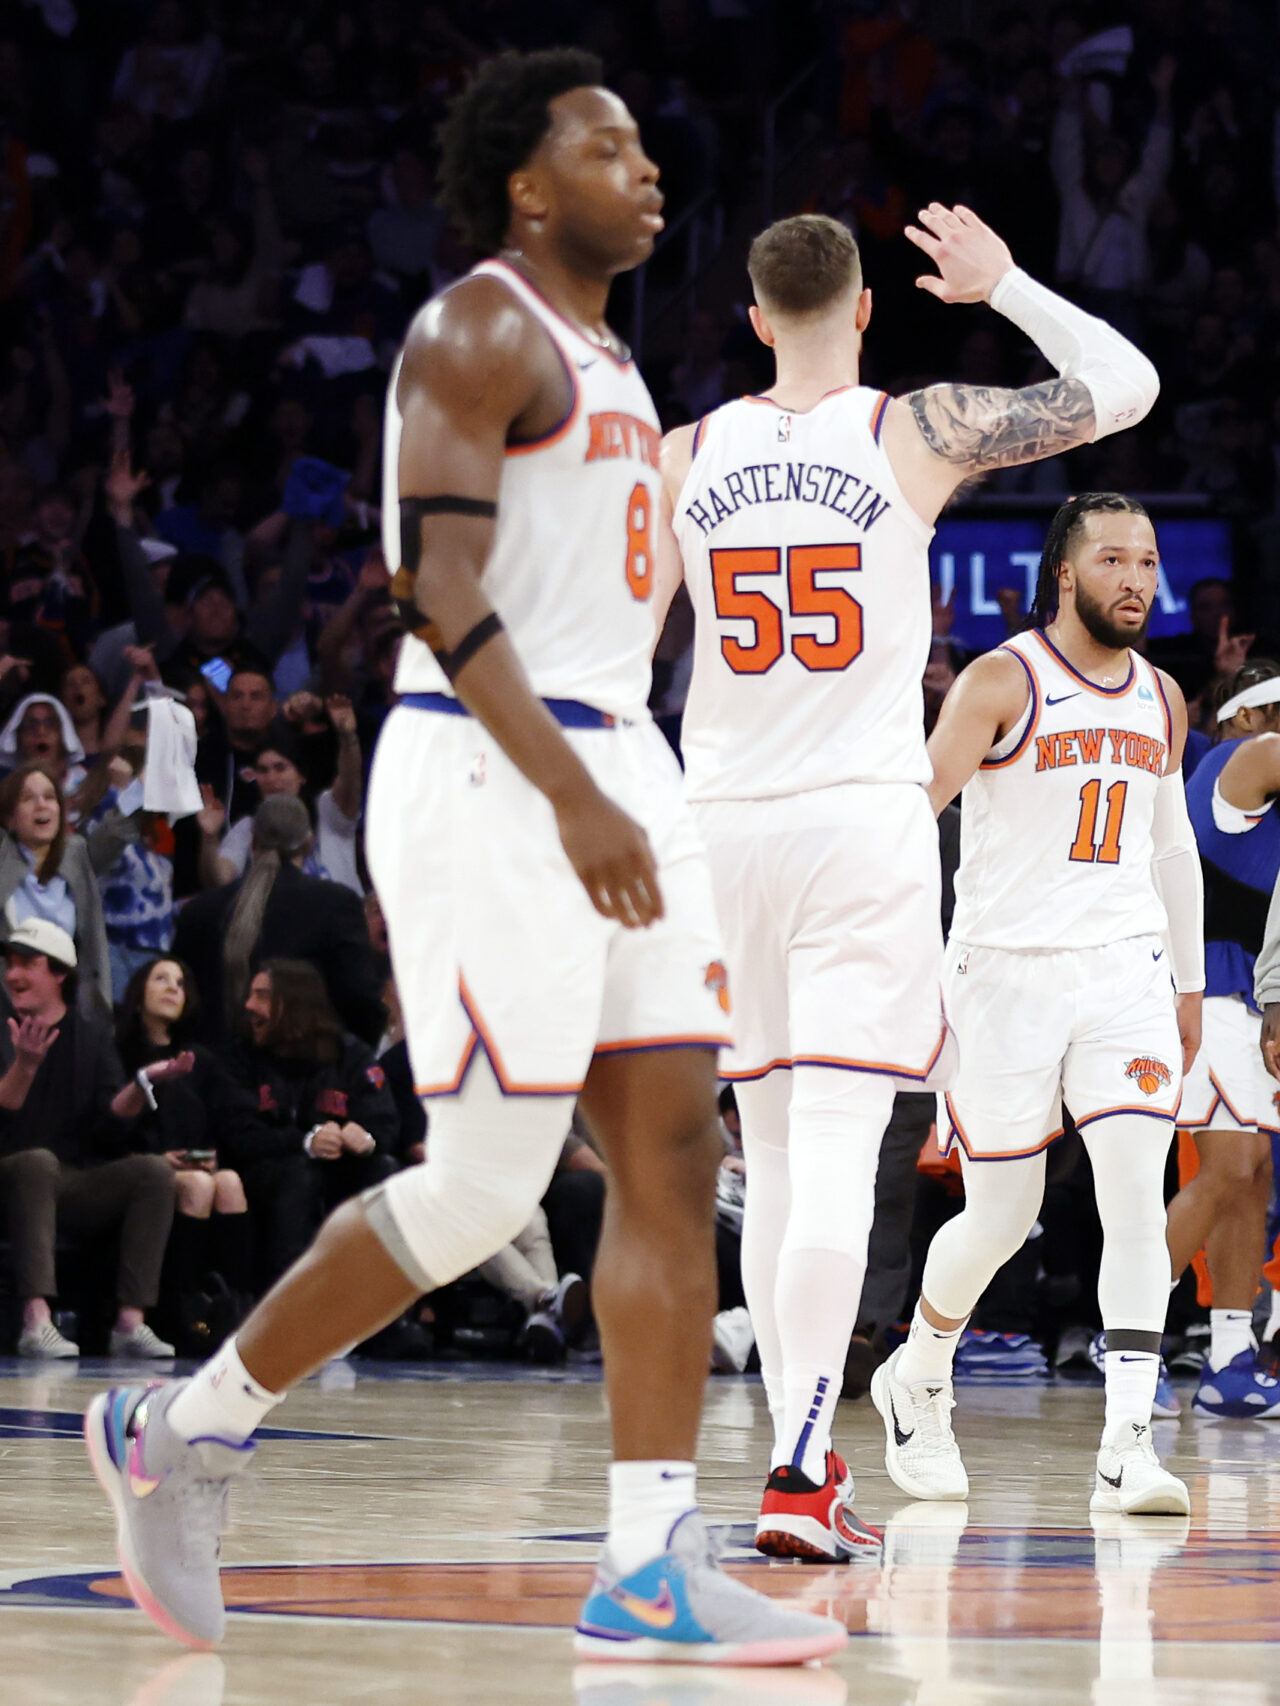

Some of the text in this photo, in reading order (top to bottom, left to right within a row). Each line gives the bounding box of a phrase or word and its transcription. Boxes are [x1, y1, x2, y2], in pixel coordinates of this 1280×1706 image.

[625, 481, 653, 602] 8
[685, 462, 891, 537] HARTENSTEIN
[709, 542, 864, 675] 55
[1035, 728, 1166, 779] NEW YORK
[1069, 778, 1128, 865] 11
